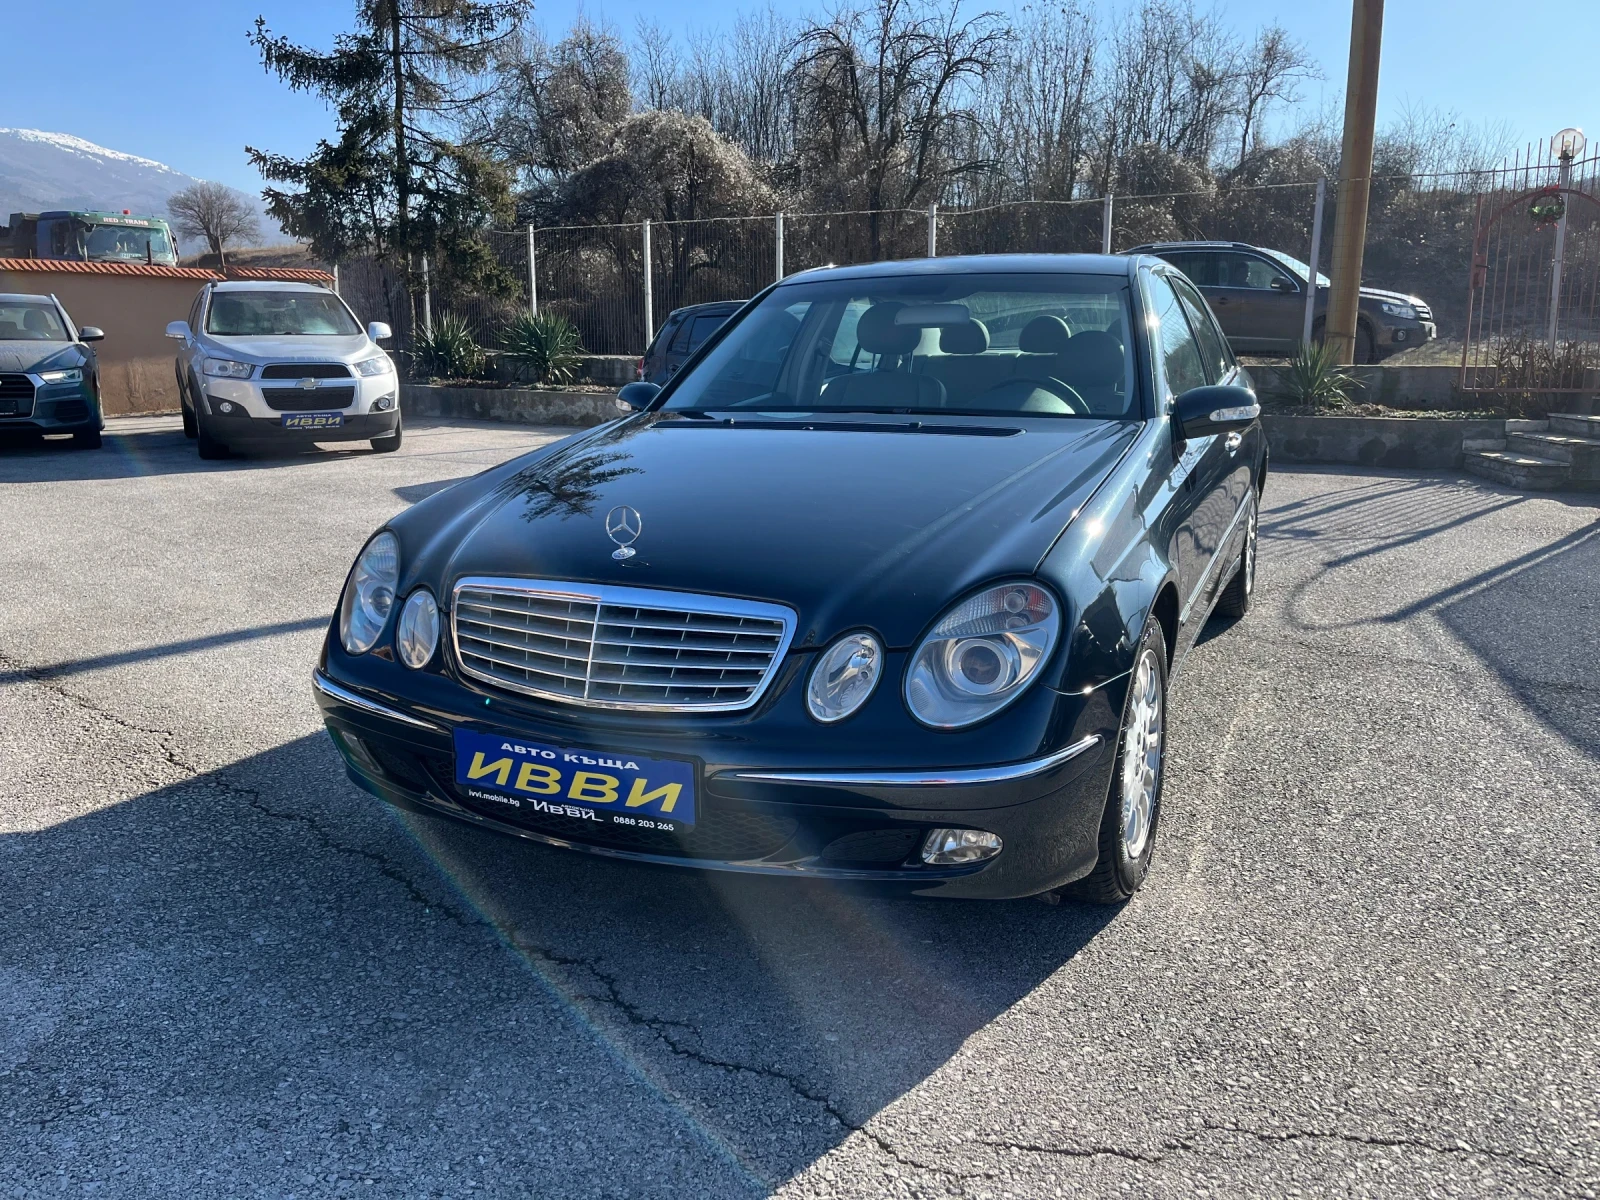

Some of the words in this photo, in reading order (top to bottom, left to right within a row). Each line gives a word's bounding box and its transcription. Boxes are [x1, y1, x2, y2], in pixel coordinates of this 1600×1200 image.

[124, 218, 148, 226] TRANS
[286, 417, 340, 426] ИВВИ
[501, 742, 556, 760] АВТО
[564, 753, 640, 771] КЪЩА
[467, 752, 683, 813] ИВВИ
[468, 789, 520, 808] ivvi.mobile.bg
[527, 798, 604, 822] ИВВИ
[613, 815, 635, 826] 0888
[638, 819, 655, 829] 203
[657, 822, 674, 831] 265
